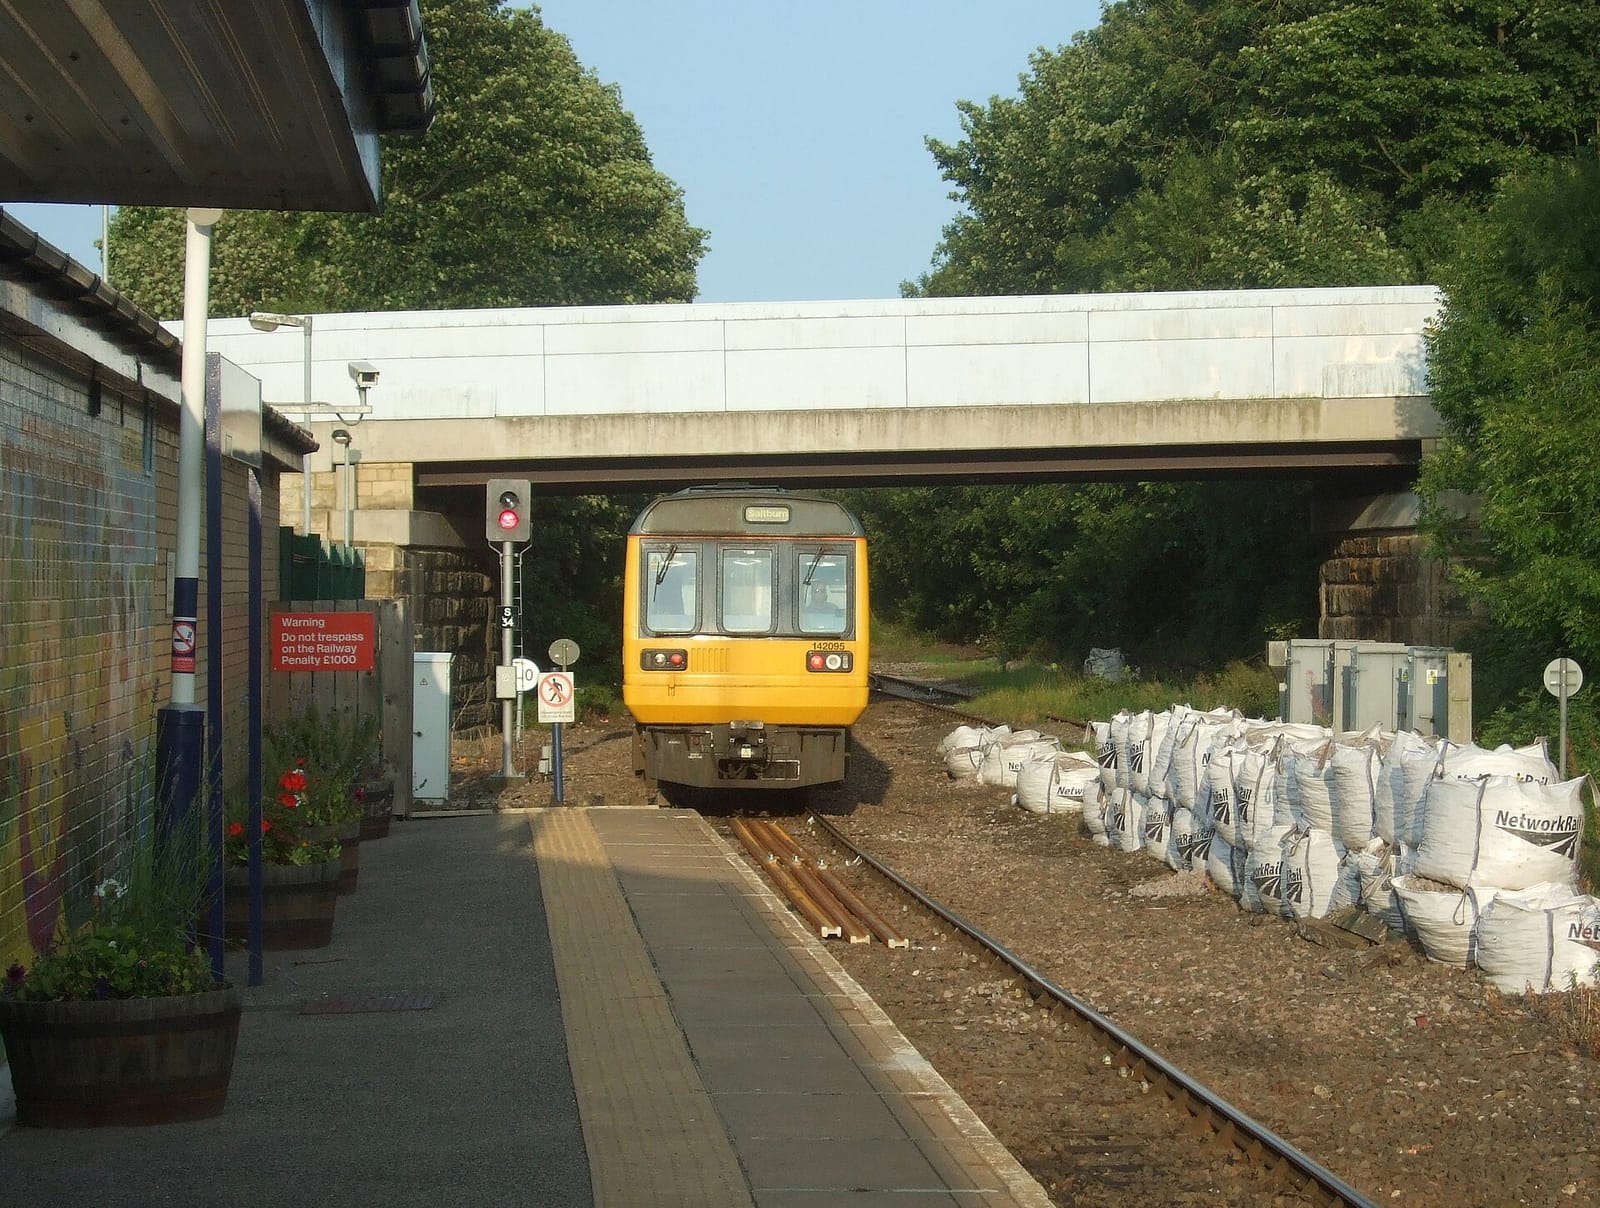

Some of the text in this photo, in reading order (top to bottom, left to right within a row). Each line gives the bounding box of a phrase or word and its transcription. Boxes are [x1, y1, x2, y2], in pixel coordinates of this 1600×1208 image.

[503, 607, 512, 616] S
[281, 617, 325, 628] Warning
[501, 617, 514, 627] 34
[281, 633, 365, 643] Do not trespass
[297, 644, 315, 653] the
[317, 644, 357, 654] Railway
[813, 642, 845, 650] 142095
[281, 655, 357, 666] Penalty £1000
[1056, 786, 1083, 795] Netw
